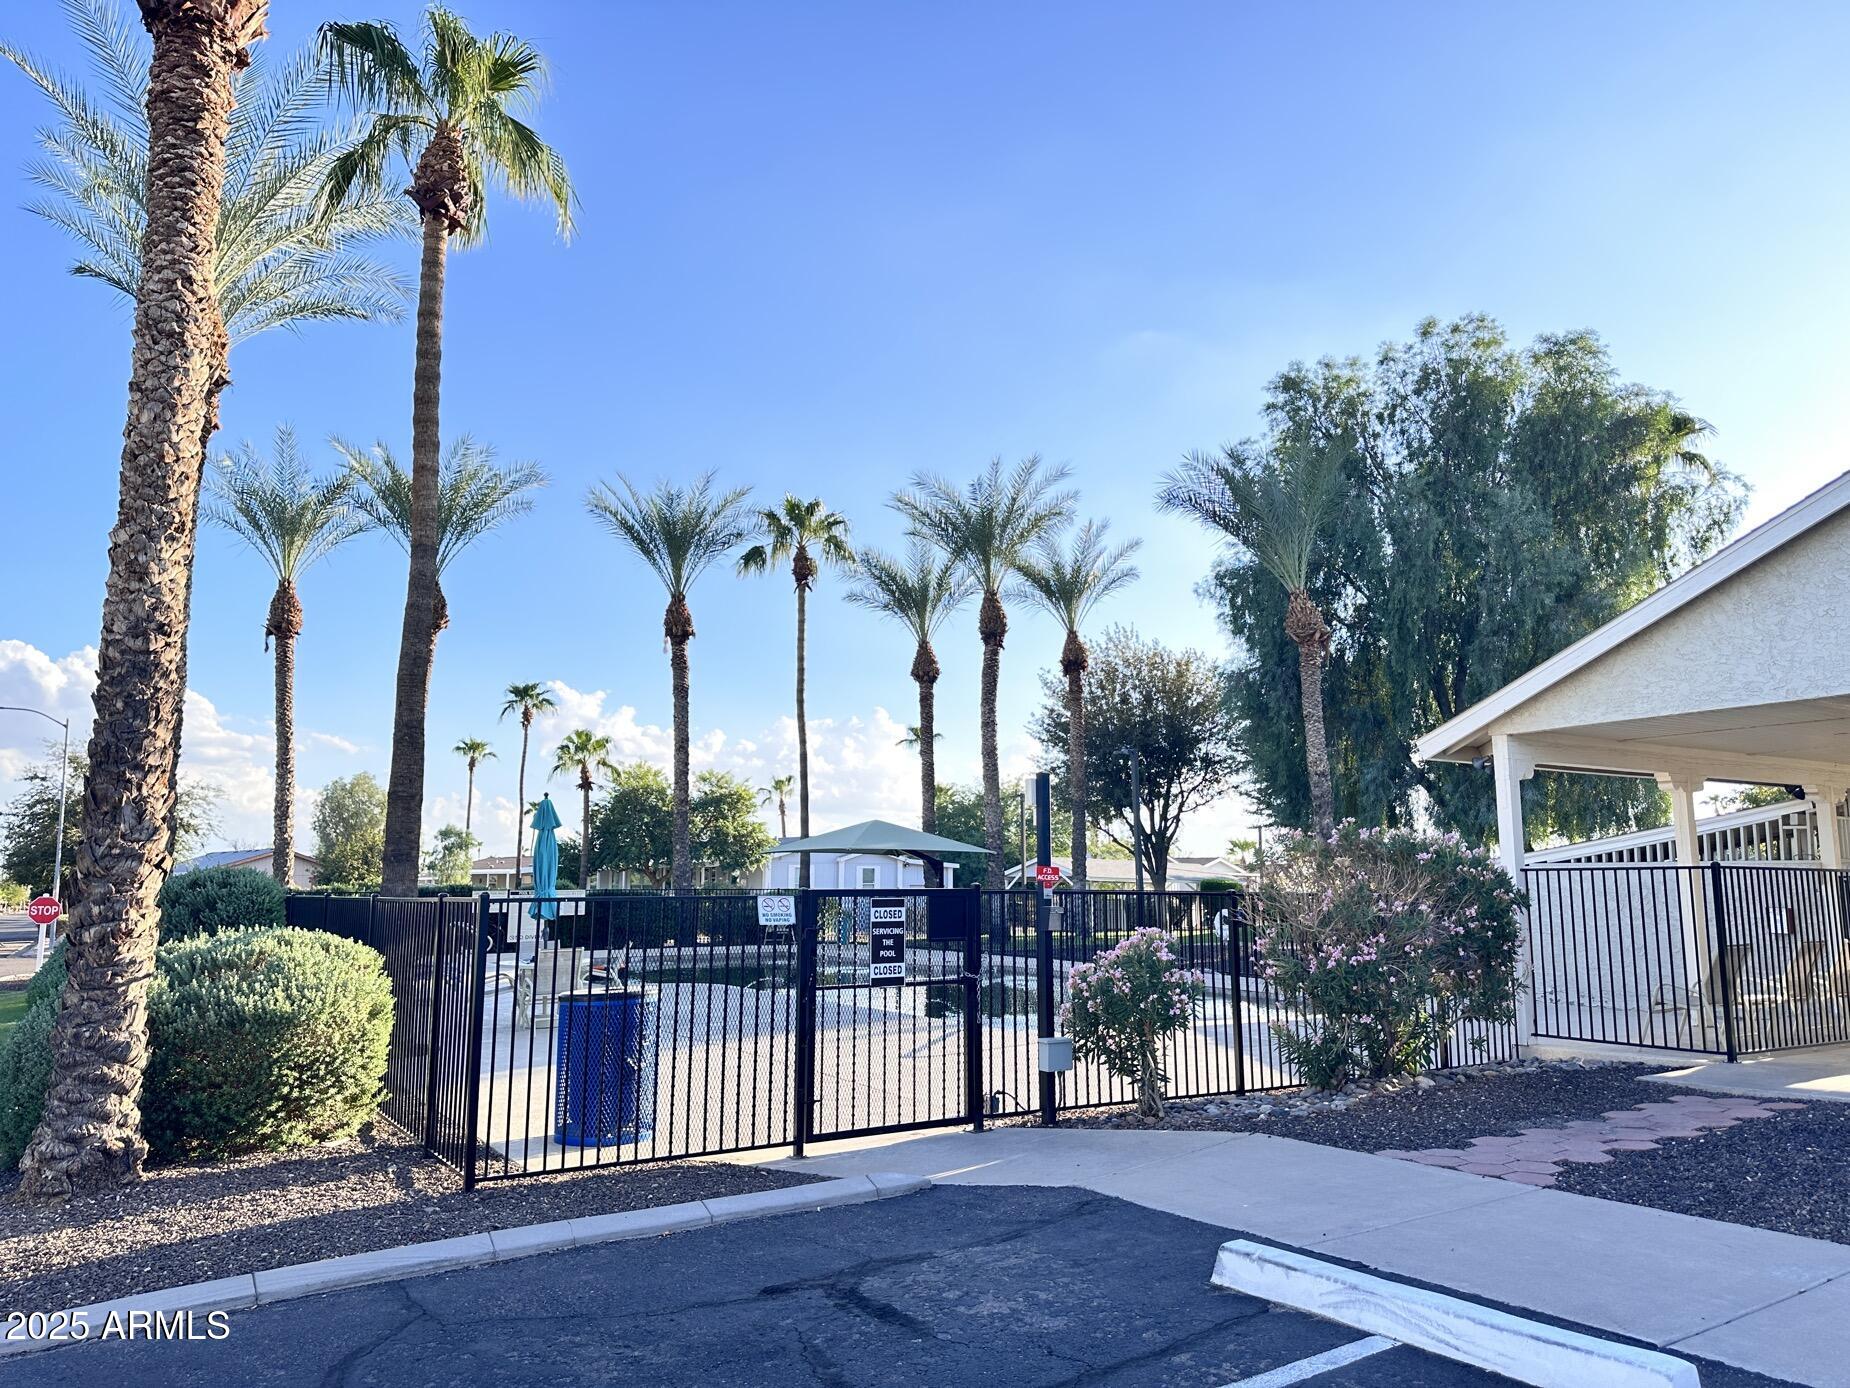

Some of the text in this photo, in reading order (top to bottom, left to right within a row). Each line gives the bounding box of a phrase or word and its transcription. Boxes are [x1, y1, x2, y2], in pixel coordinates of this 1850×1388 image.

[30, 905, 59, 916] STOP
[873, 909, 903, 919] CLOSED
[873, 966, 903, 976] CLOSED
